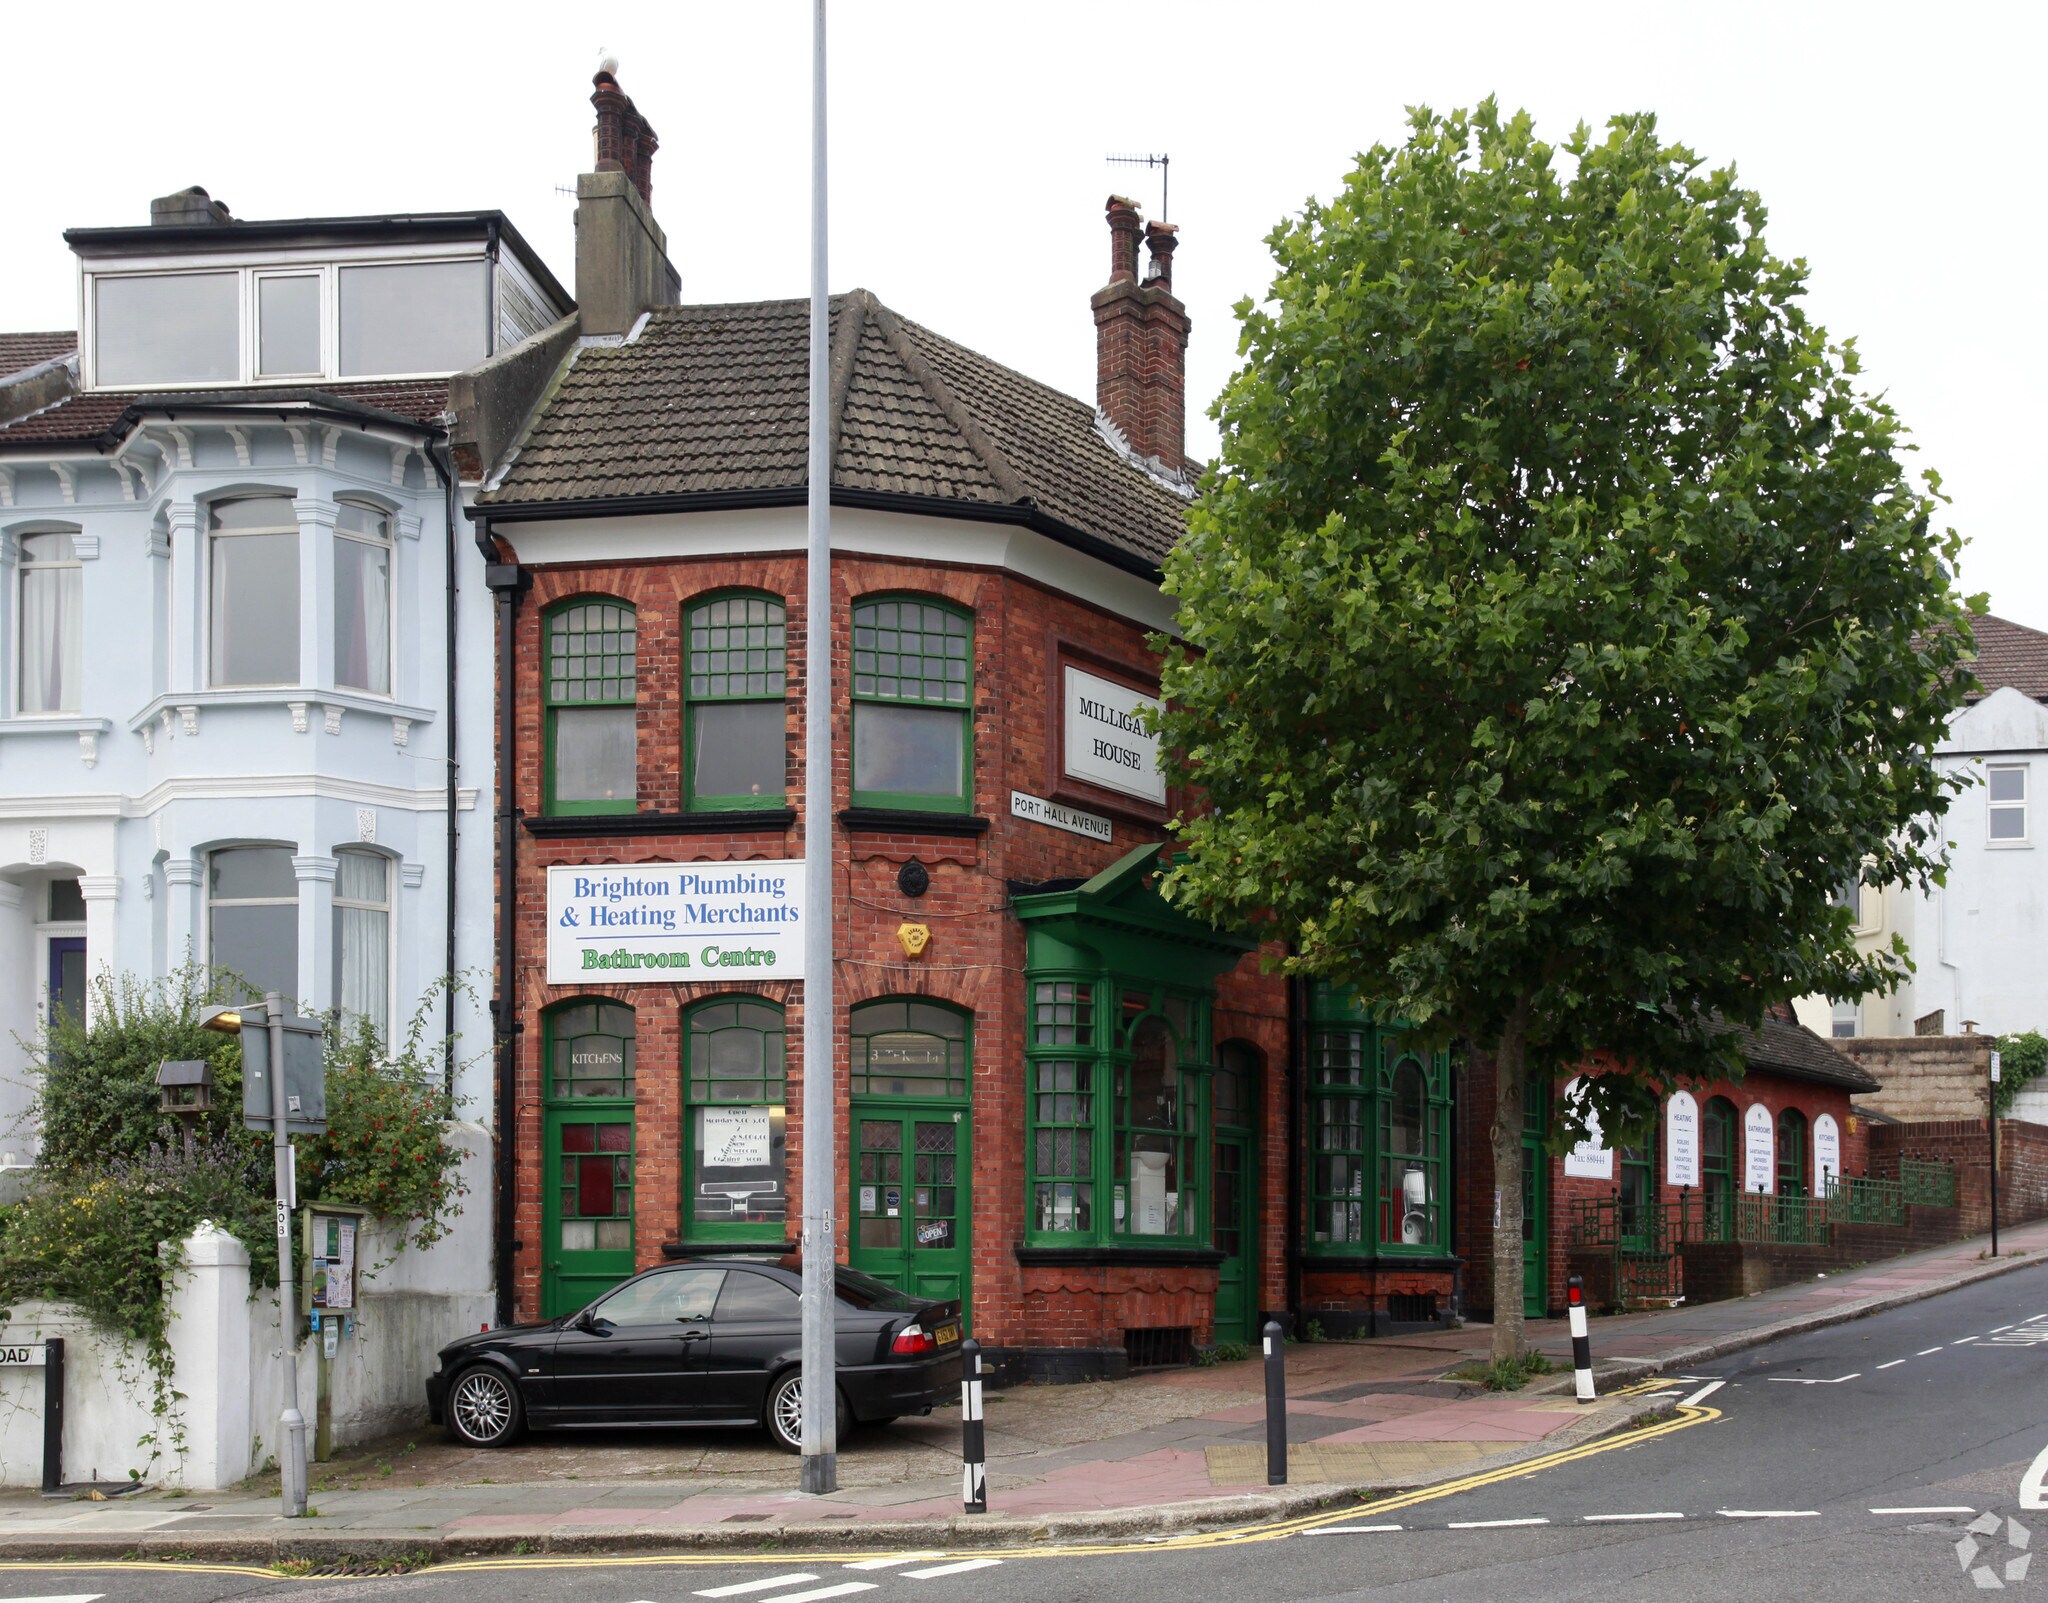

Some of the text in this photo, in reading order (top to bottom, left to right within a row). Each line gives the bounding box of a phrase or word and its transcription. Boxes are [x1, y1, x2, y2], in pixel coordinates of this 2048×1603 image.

[1093, 738, 1141, 770] HOUSE
[1014, 797, 1109, 836] PORT HALL AVENUE
[573, 873, 786, 903] Brighton Plumbing
[560, 901, 799, 931] & Heating Merchants
[581, 945, 777, 970] Bathroom Centre
[1673, 1113, 1692, 1122] HEATING
[1748, 1124, 1771, 1134] BATHROOMS
[1819, 1134, 1834, 1142] KITCHENS
[925, 1227, 943, 1239] OPEN
